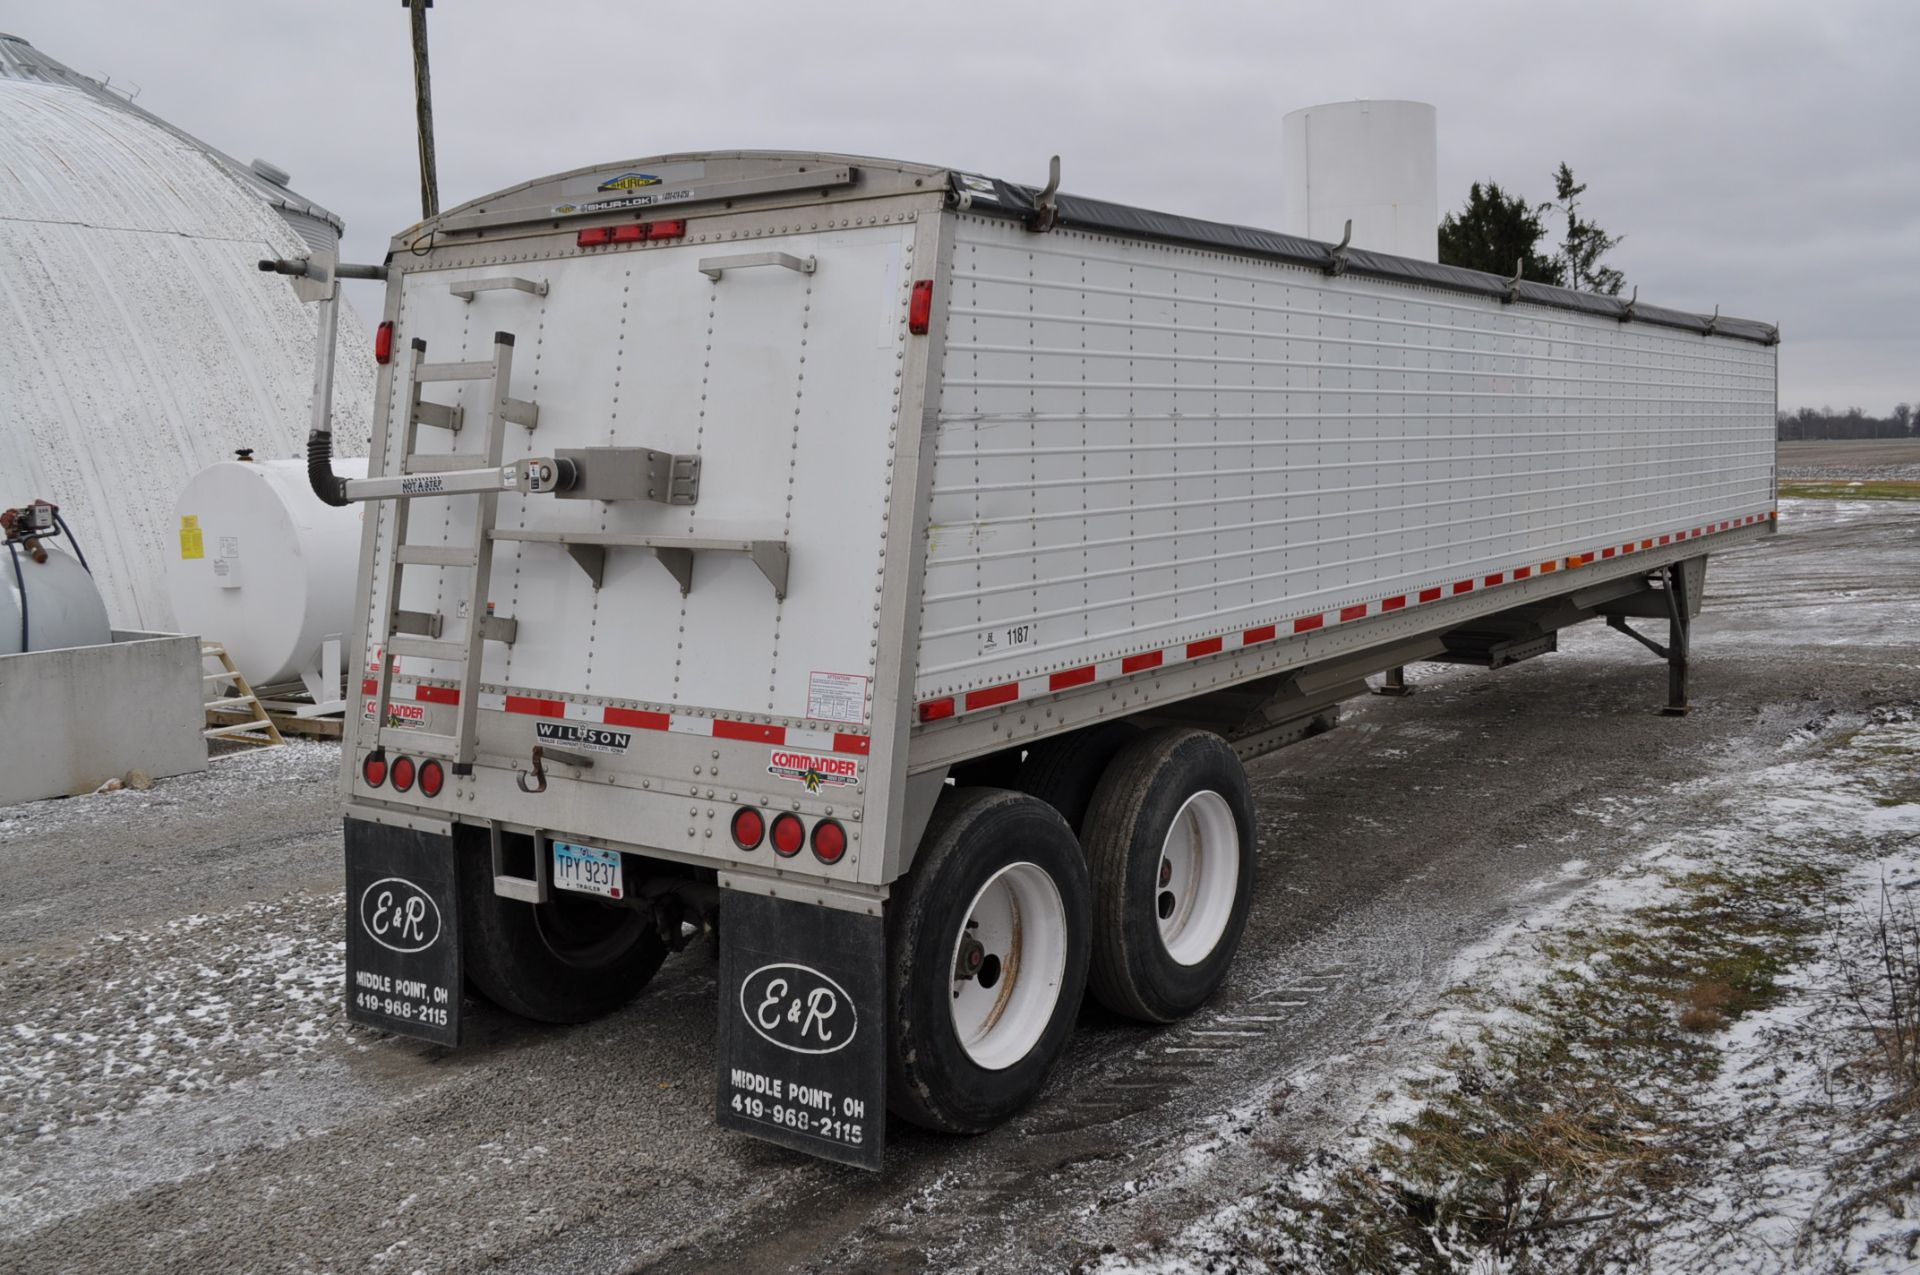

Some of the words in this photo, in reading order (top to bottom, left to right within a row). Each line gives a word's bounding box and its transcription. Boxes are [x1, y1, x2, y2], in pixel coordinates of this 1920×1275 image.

[587, 196, 650, 212] SHUR-LOK
[402, 481, 417, 490] NOT
[418, 481, 424, 489] A
[424, 479, 442, 488] STEP
[1007, 625, 1029, 645] 1187
[539, 724, 627, 746] WILSON
[772, 752, 856, 776] COMMANDER
[558, 854, 580, 881] TPY
[585, 859, 616, 886] 9237
[576, 883, 601, 892] TRAILER
[356, 971, 391, 993] MIDDLE
[396, 980, 431, 1004] POINT,
[434, 986, 448, 1004] OH
[357, 992, 448, 1026] 419-968-2115
[731, 1069, 782, 1098] MIDDLE
[789, 1083, 836, 1115] POINT,
[843, 1097, 864, 1119] OH
[731, 1094, 863, 1144] 419-968-2115
